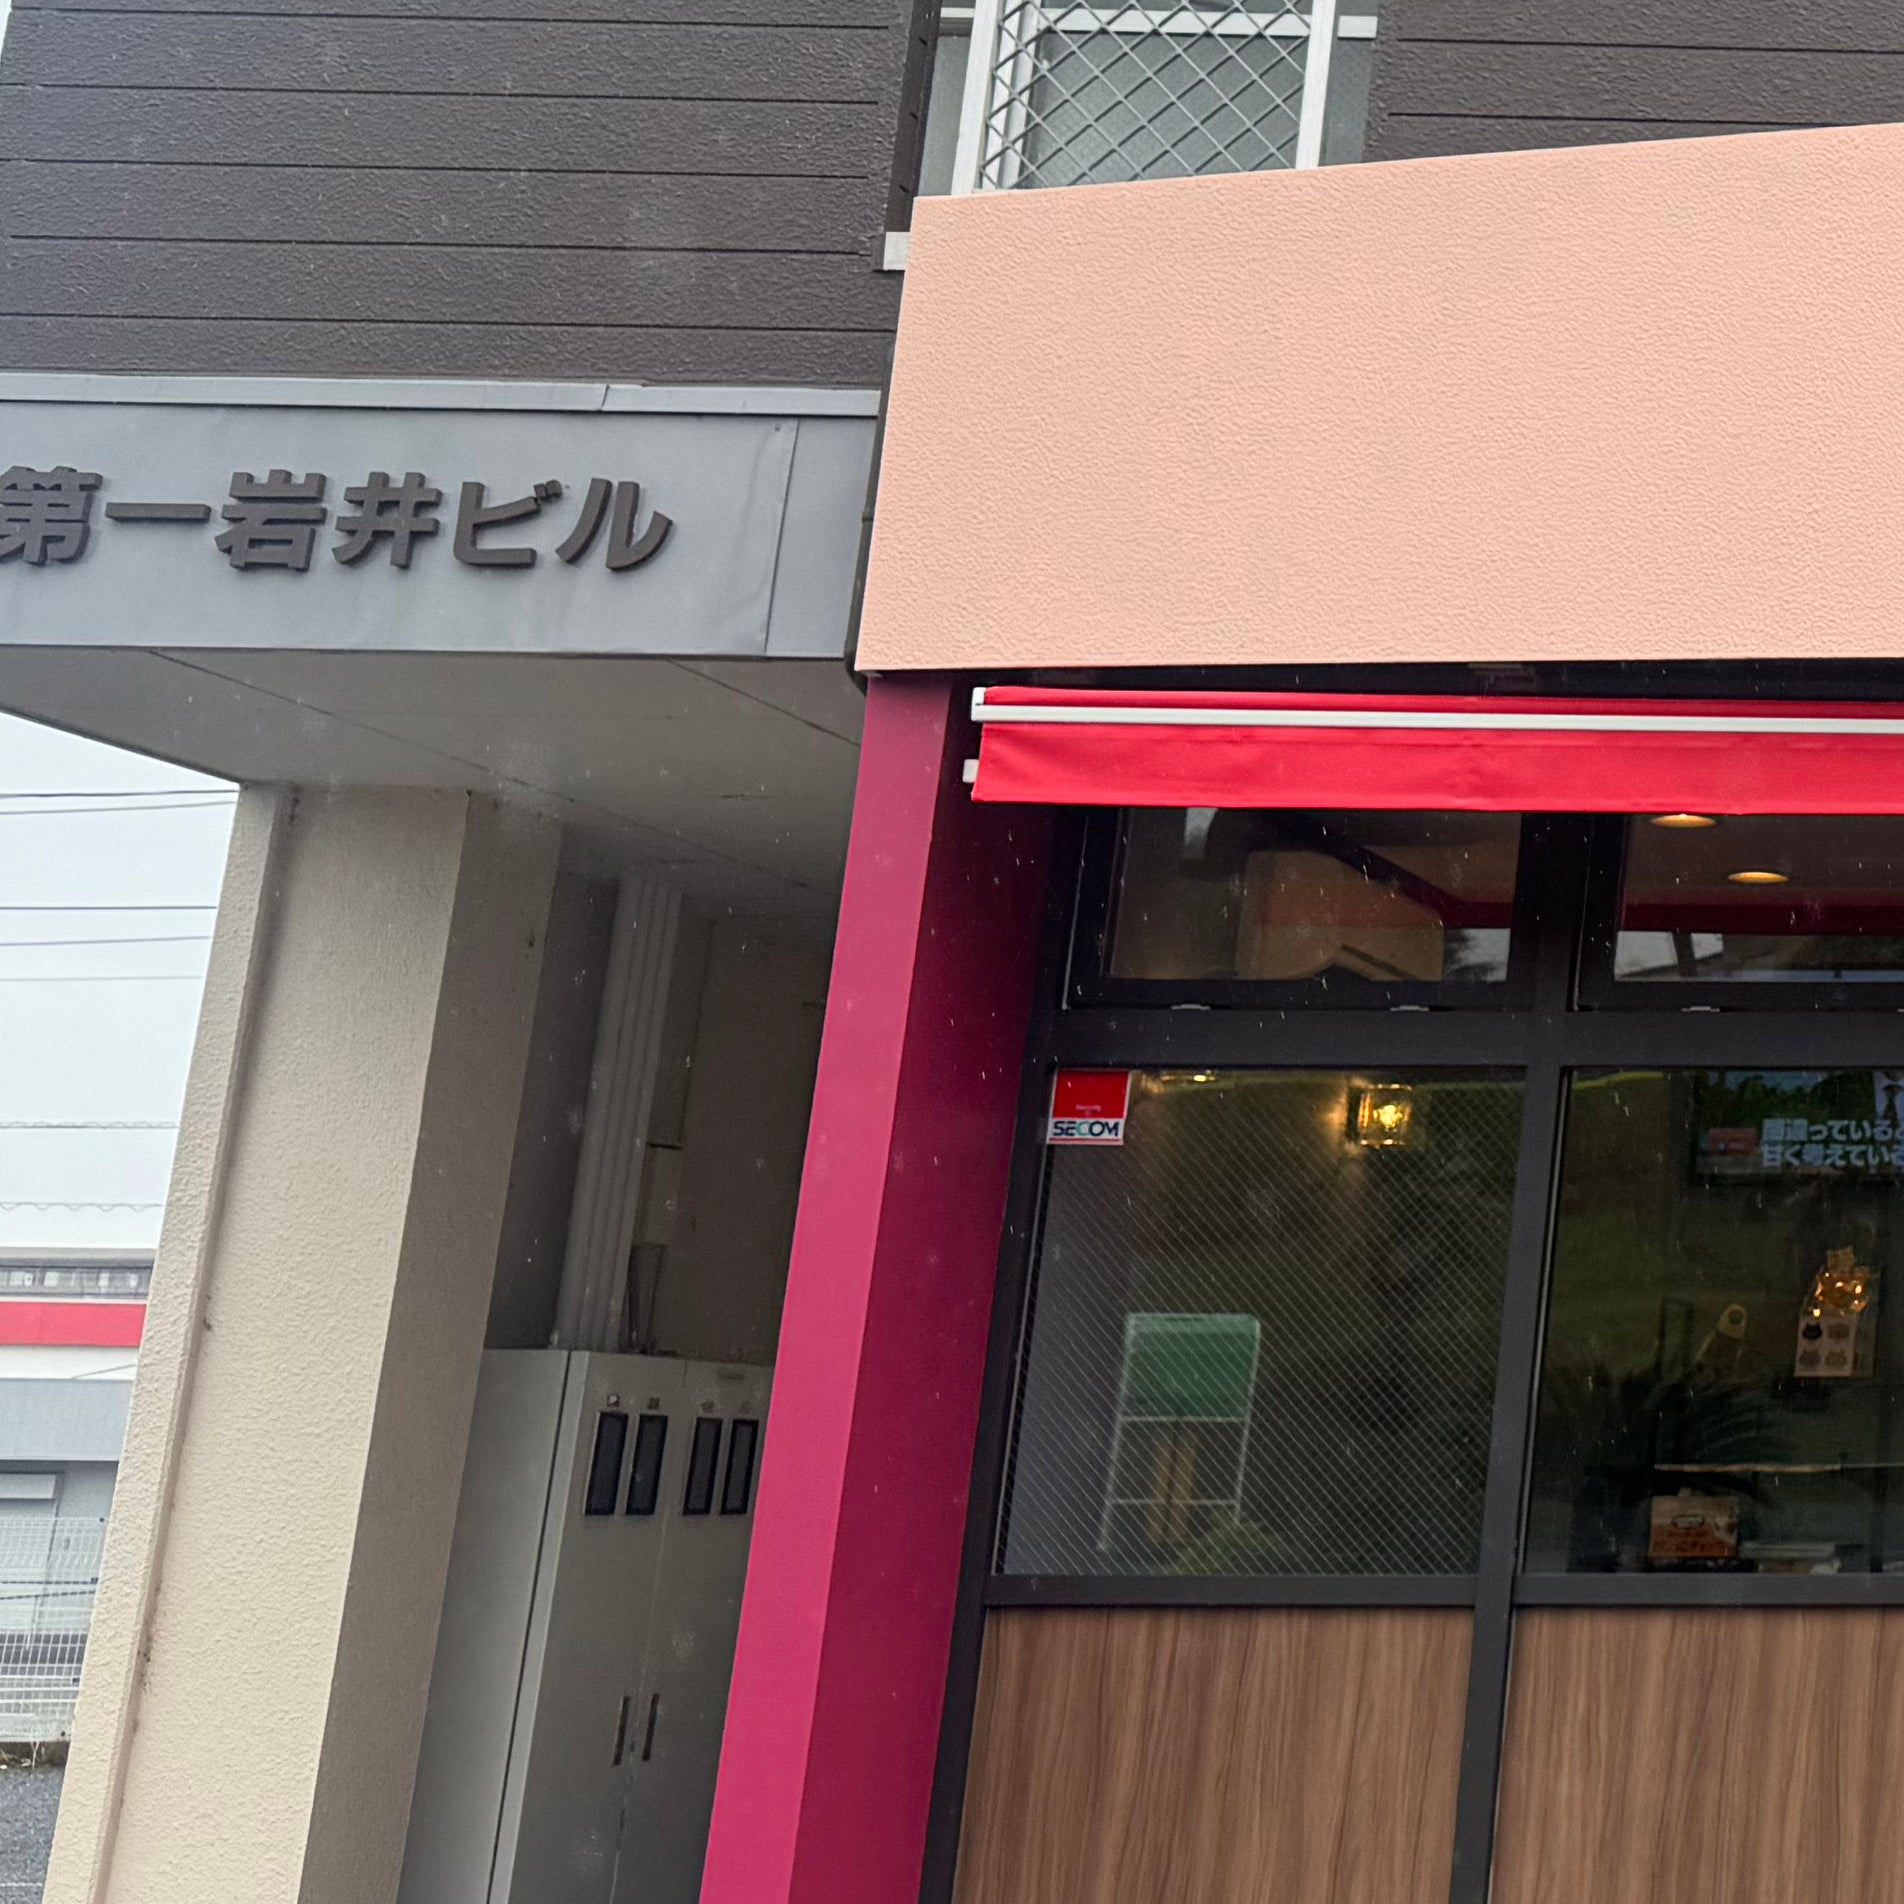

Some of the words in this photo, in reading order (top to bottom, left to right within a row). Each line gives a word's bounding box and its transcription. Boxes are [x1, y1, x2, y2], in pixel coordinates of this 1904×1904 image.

[0, 466, 673, 570] 第一岩井ビル
[1053, 1120, 1120, 1137] SECOM
